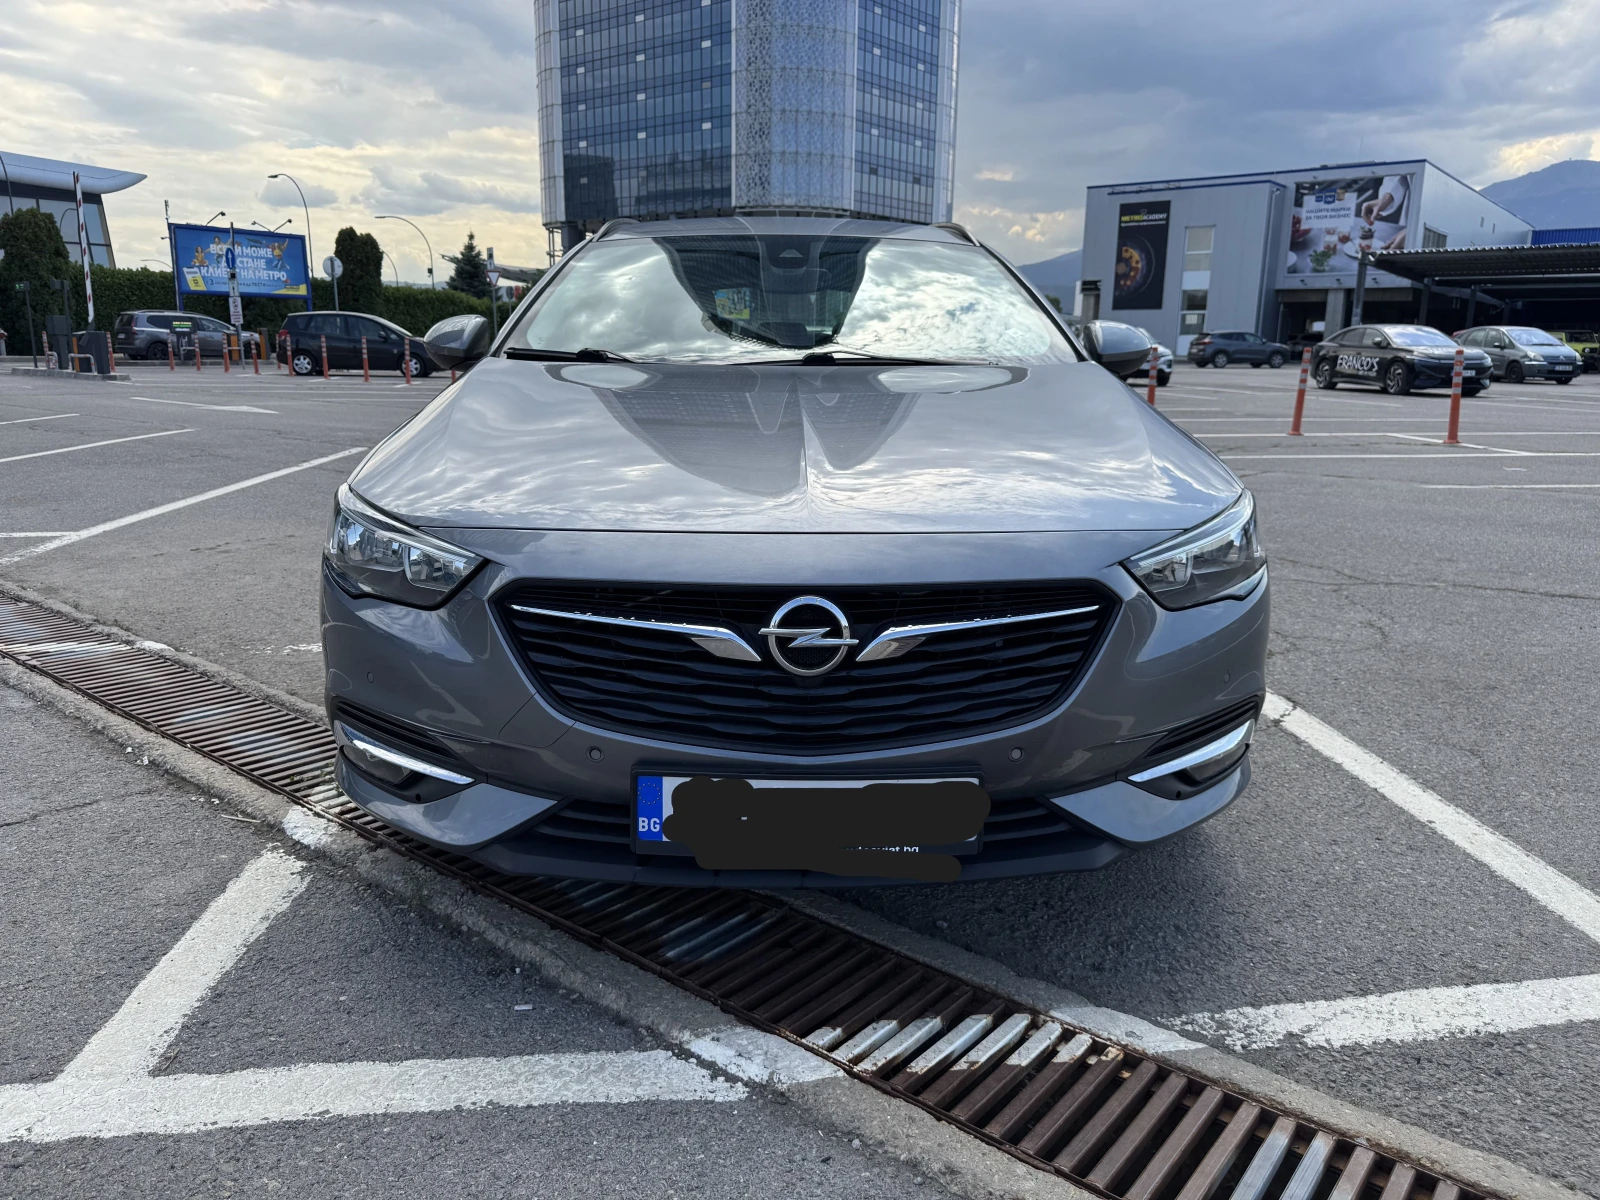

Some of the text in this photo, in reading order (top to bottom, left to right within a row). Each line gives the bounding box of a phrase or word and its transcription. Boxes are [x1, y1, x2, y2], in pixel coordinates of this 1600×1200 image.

[209, 243, 273, 258] ВСЕИ МОЖЕ
[236, 257, 267, 268] СТАНЕ
[241, 269, 256, 279] НА
[256, 270, 287, 281] МЕТРО
[638, 817, 661, 832] BG
